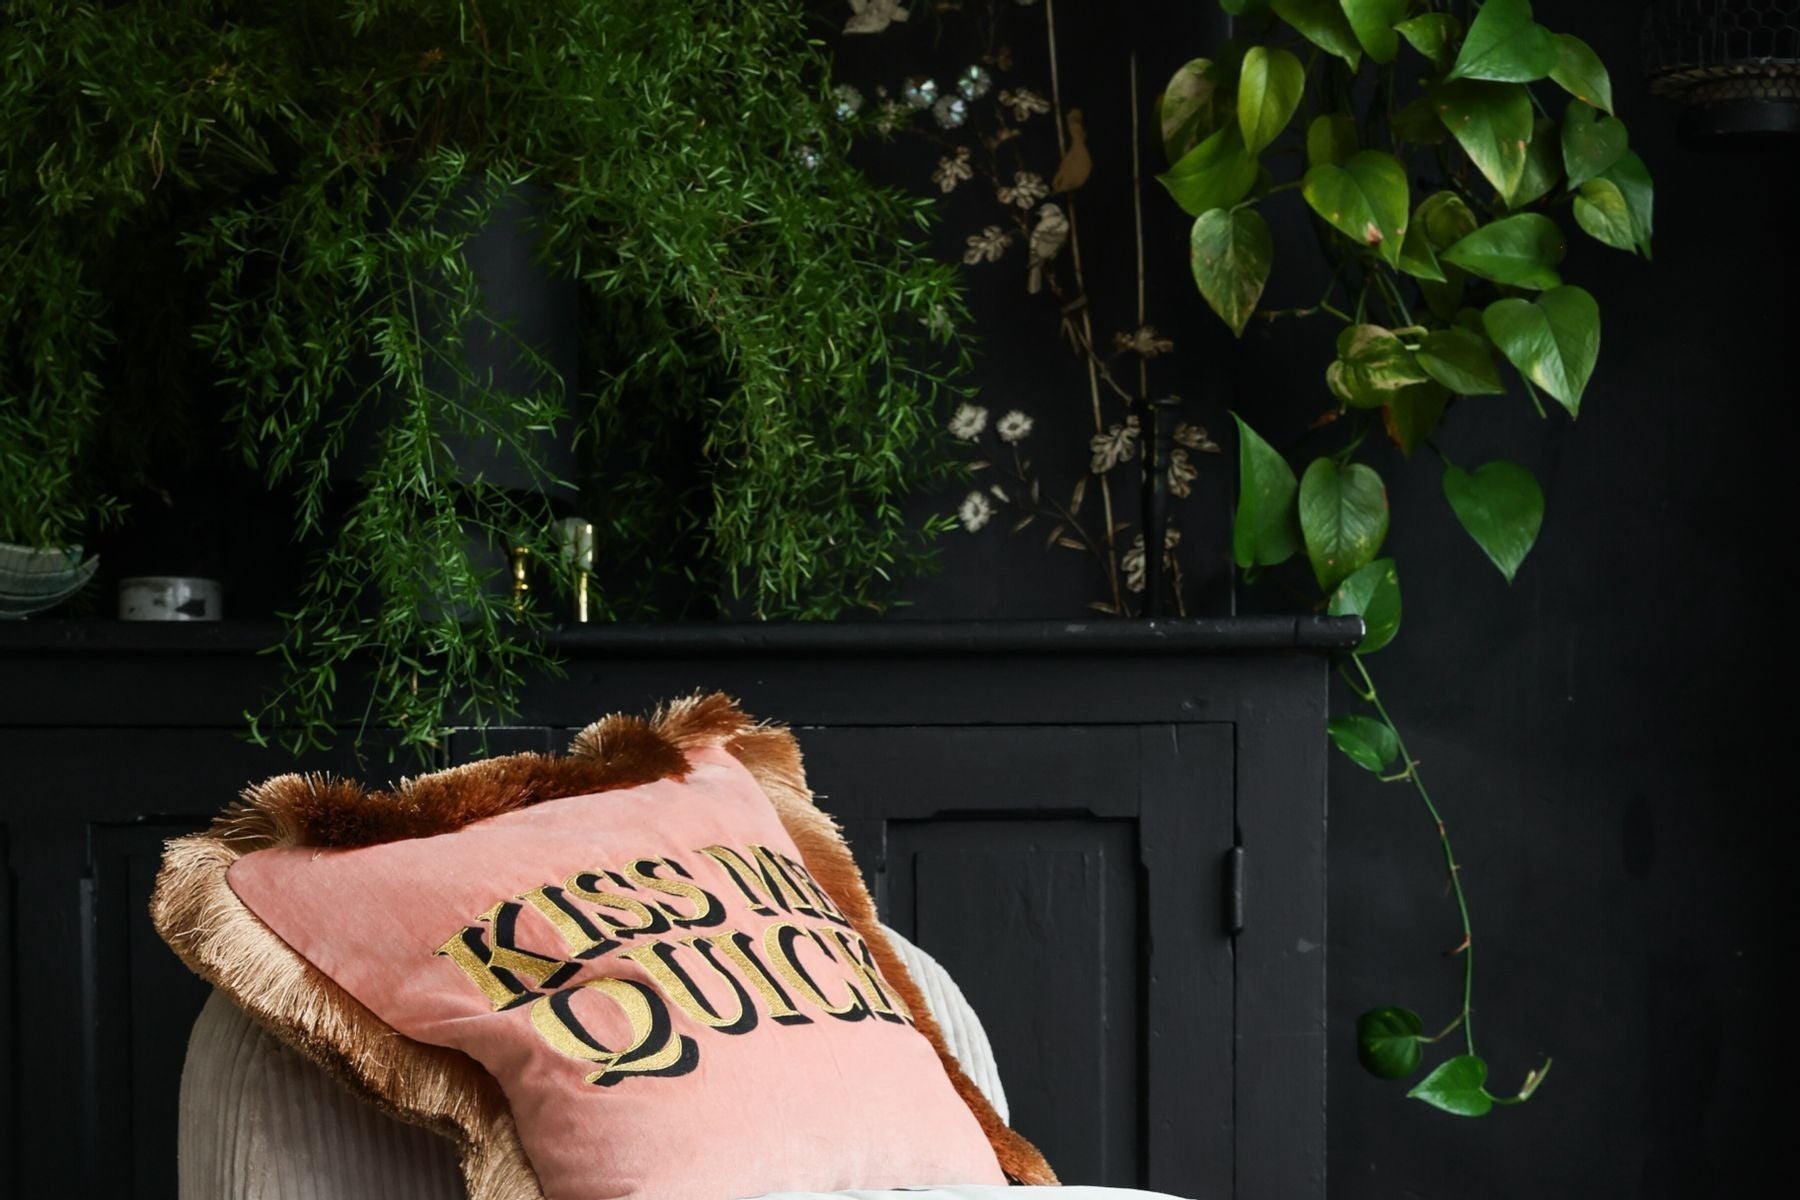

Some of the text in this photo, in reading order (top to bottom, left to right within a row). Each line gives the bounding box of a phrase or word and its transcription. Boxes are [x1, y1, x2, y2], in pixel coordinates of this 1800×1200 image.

[432, 842, 856, 1012] KISS ME
[529, 920, 916, 1087] QUICK
